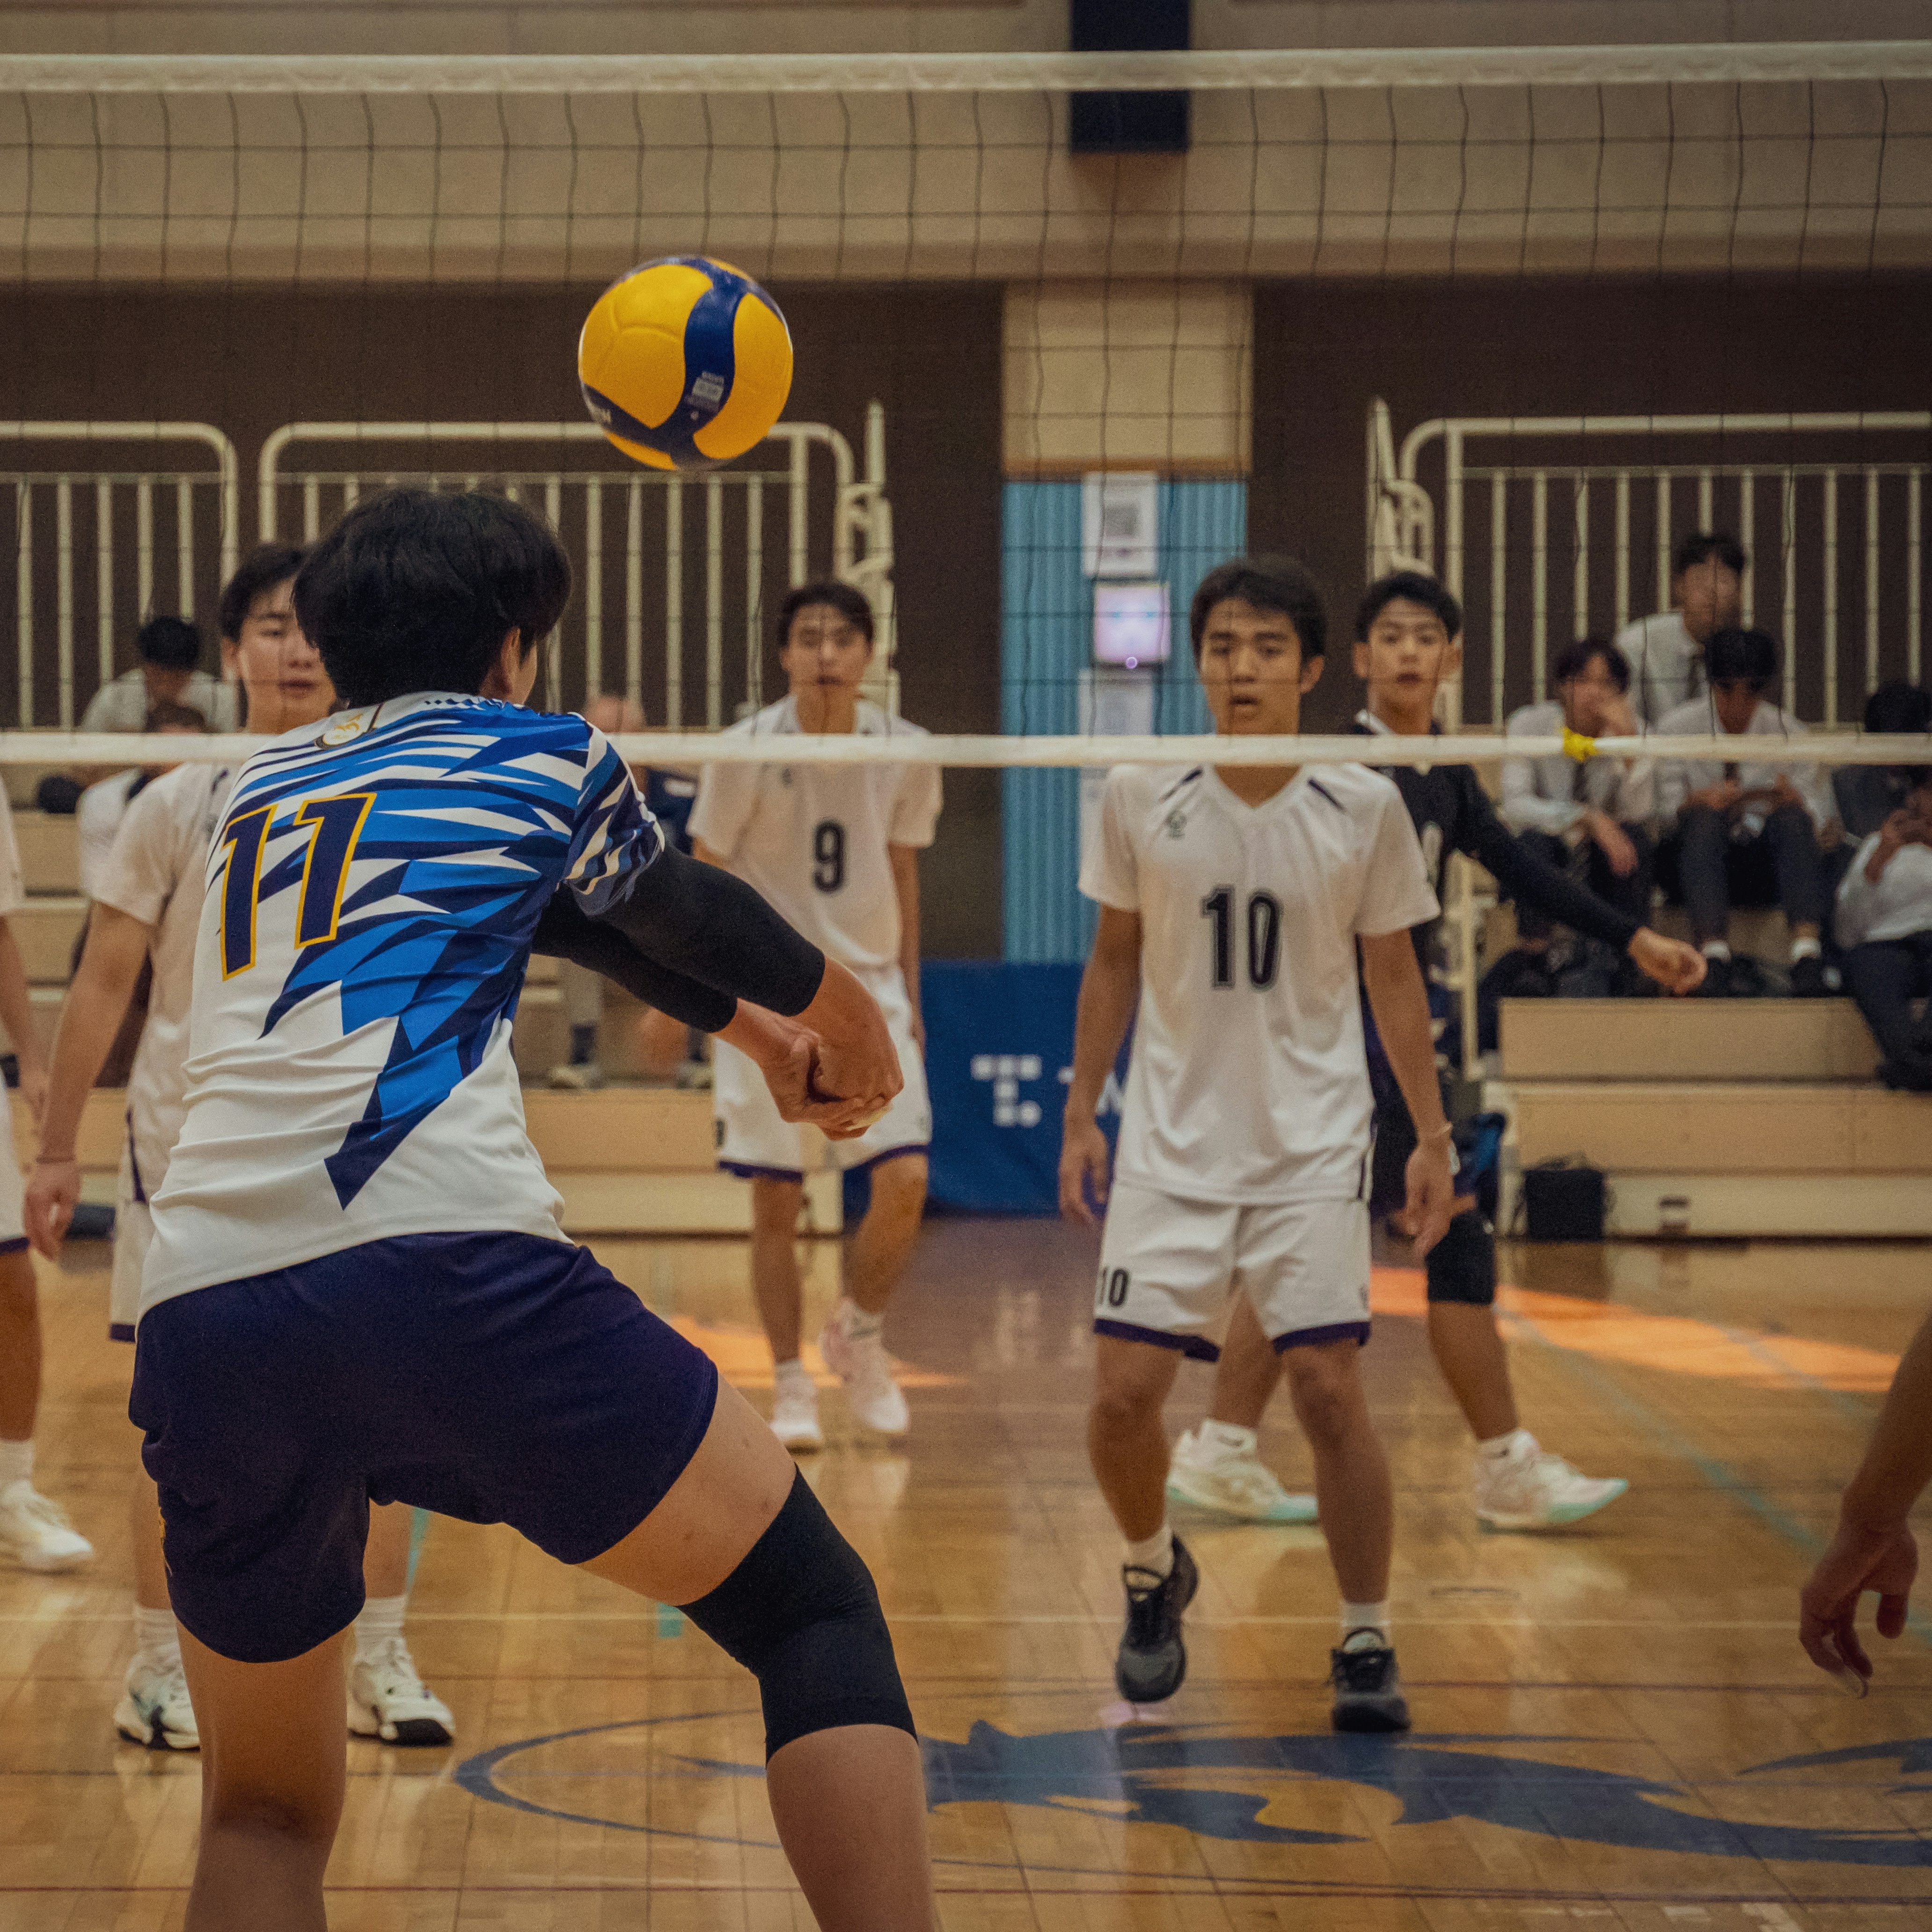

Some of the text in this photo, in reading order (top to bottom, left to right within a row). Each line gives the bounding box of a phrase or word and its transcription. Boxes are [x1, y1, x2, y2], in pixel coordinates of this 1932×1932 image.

[220, 792, 377, 982] 11
[812, 819, 846, 894] 9
[1201, 883, 1283, 992] 10
[1098, 1266, 1131, 1308] 10
